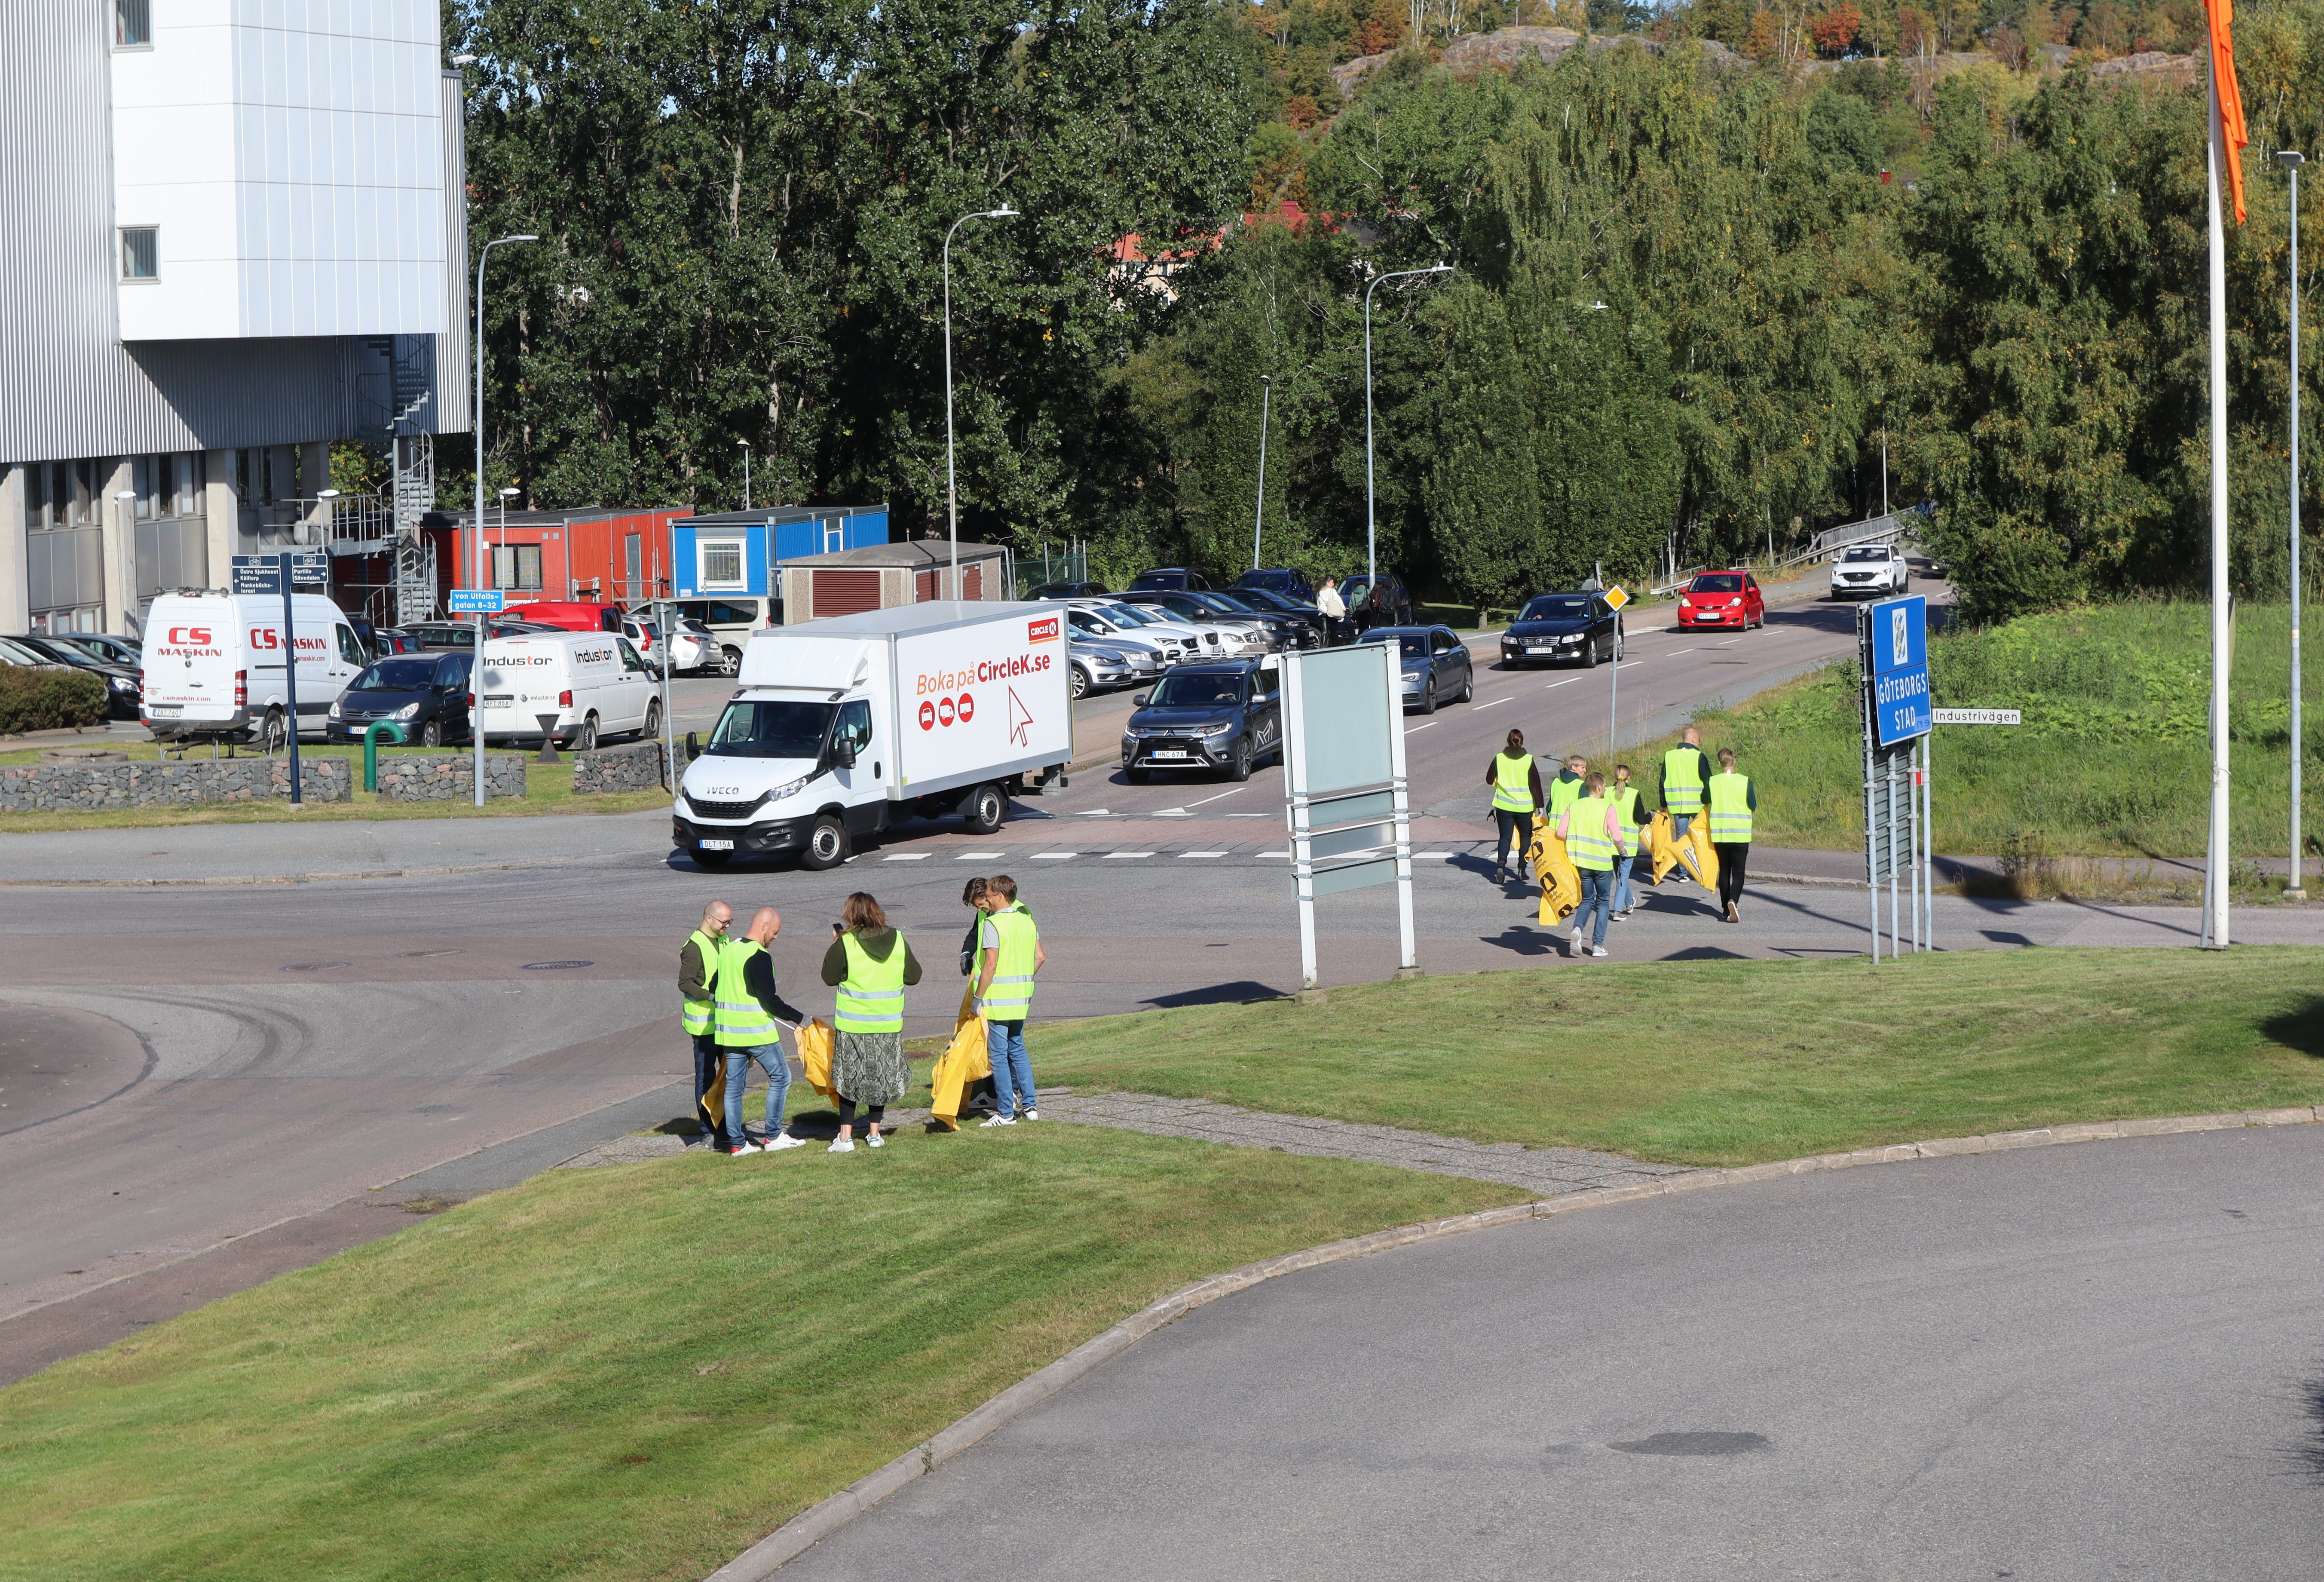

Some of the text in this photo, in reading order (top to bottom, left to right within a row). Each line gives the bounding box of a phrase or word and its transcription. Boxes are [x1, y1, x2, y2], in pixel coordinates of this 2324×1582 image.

[168, 627, 211, 645] CS
[1030, 622, 1056, 636] CIRCLE K
[250, 629, 327, 650] CS MASKIN
[158, 648, 222, 657] MASKIN
[484, 656, 553, 666] Industor
[574, 648, 613, 664] Industor
[916, 653, 1050, 696] Boka på CircleK.se
[1879, 672, 1926, 705] GÖTEBORGS
[1895, 706, 1916, 731] STAD
[1936, 711, 2018, 724] Industrivägen
